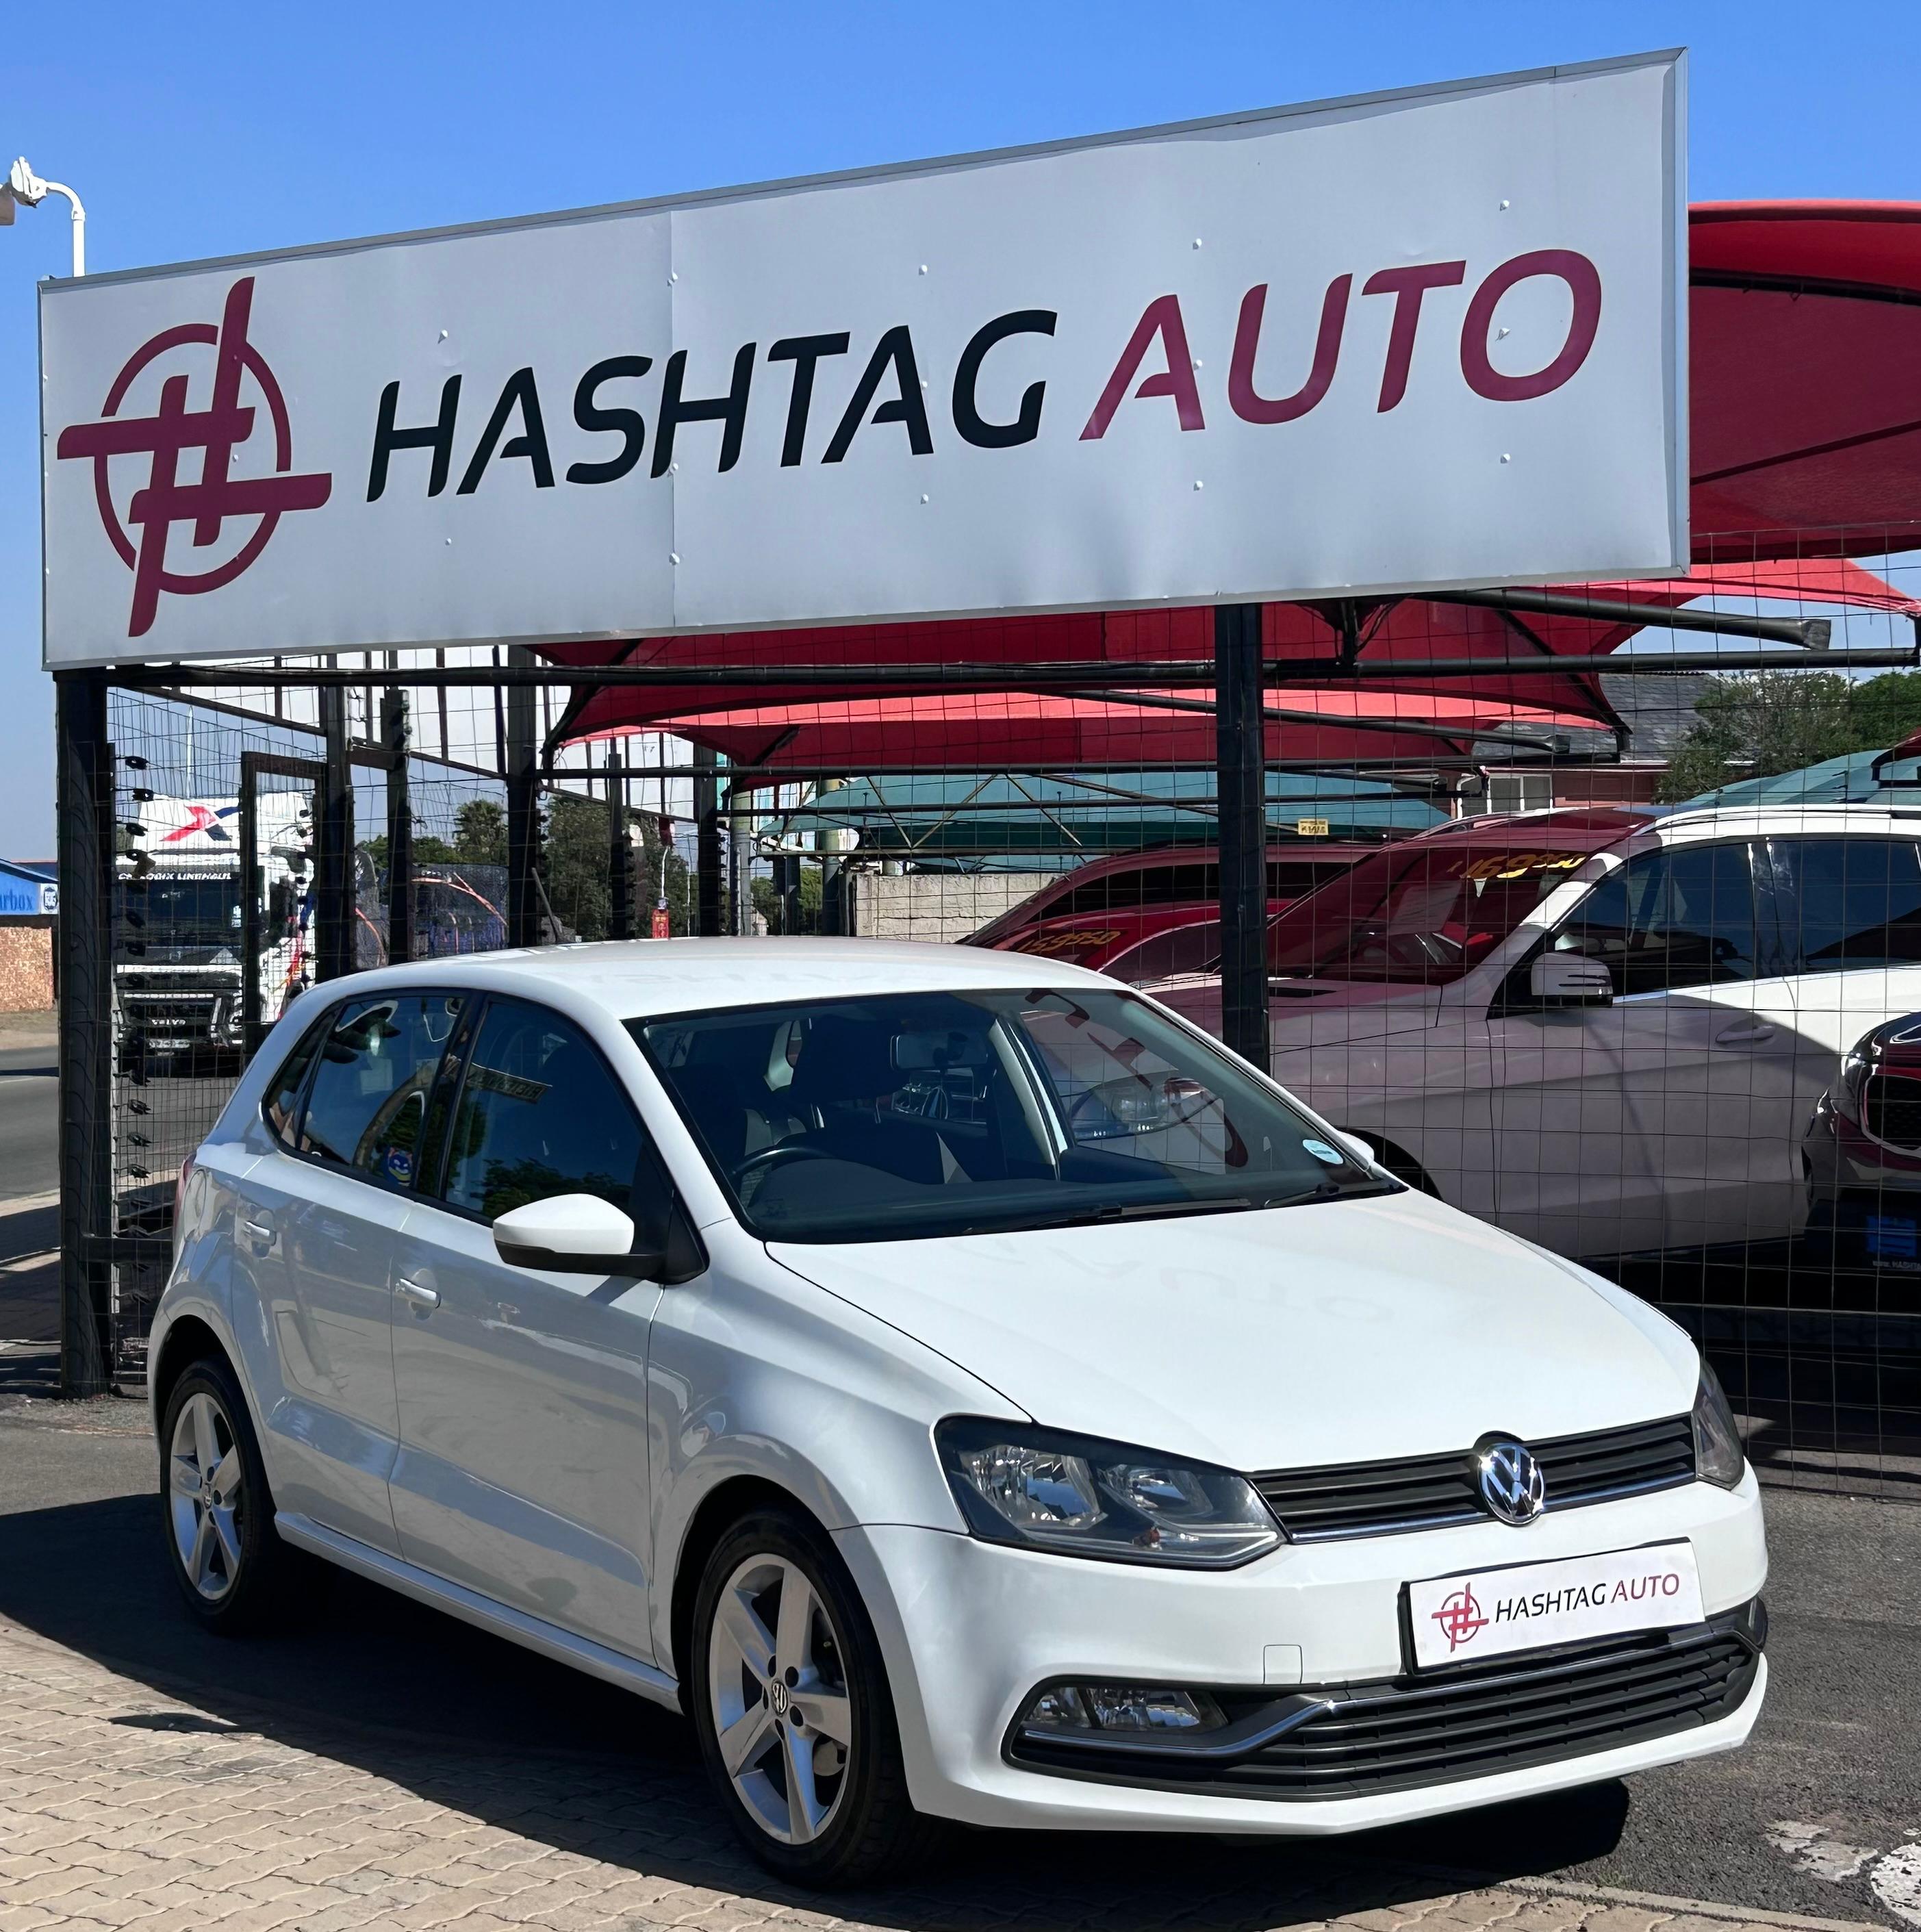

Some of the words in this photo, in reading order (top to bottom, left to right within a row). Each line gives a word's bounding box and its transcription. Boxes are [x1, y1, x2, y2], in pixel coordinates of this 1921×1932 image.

[366, 309, 1058, 503] HASHTAG
[1082, 251, 1600, 439] AUTO
[1495, 1582, 1606, 1623] HASHTAG
[1610, 1573, 1679, 1604] AUTO
